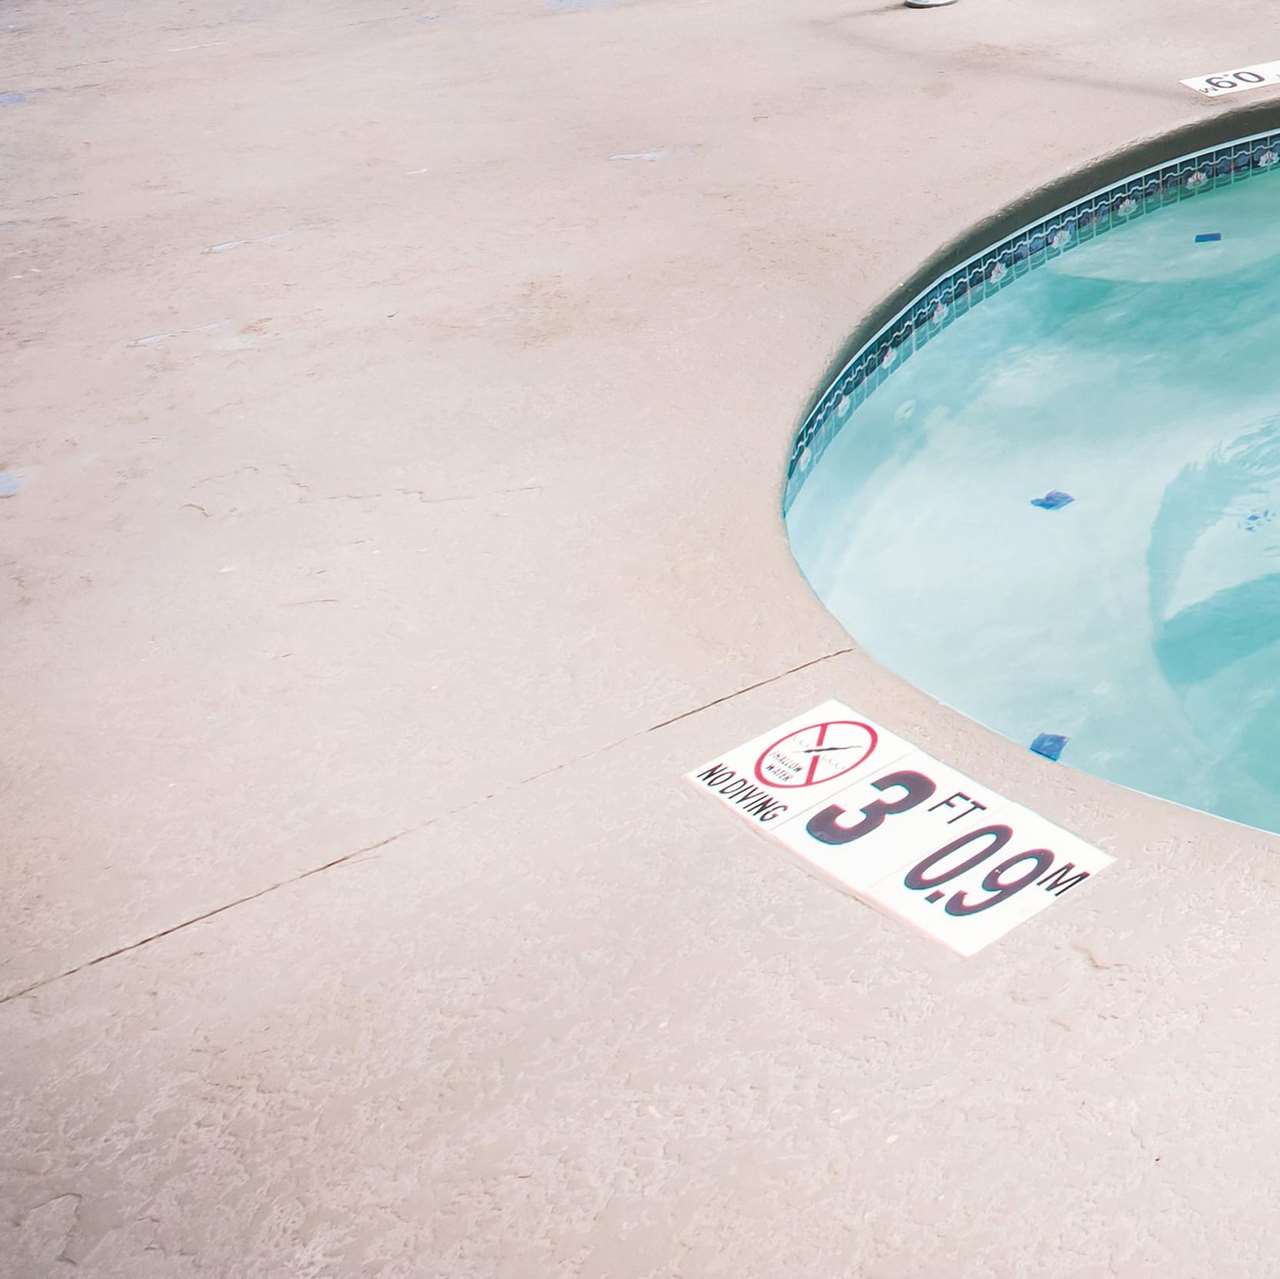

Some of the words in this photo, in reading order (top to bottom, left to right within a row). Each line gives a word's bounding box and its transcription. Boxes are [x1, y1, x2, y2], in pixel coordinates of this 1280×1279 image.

[696, 762, 737, 787] NO
[718, 778, 789, 822] DIVING
[805, 770, 937, 846] 3
[928, 791, 987, 825] FT
[904, 824, 1056, 917] 0.9
[1036, 862, 1091, 897] M
